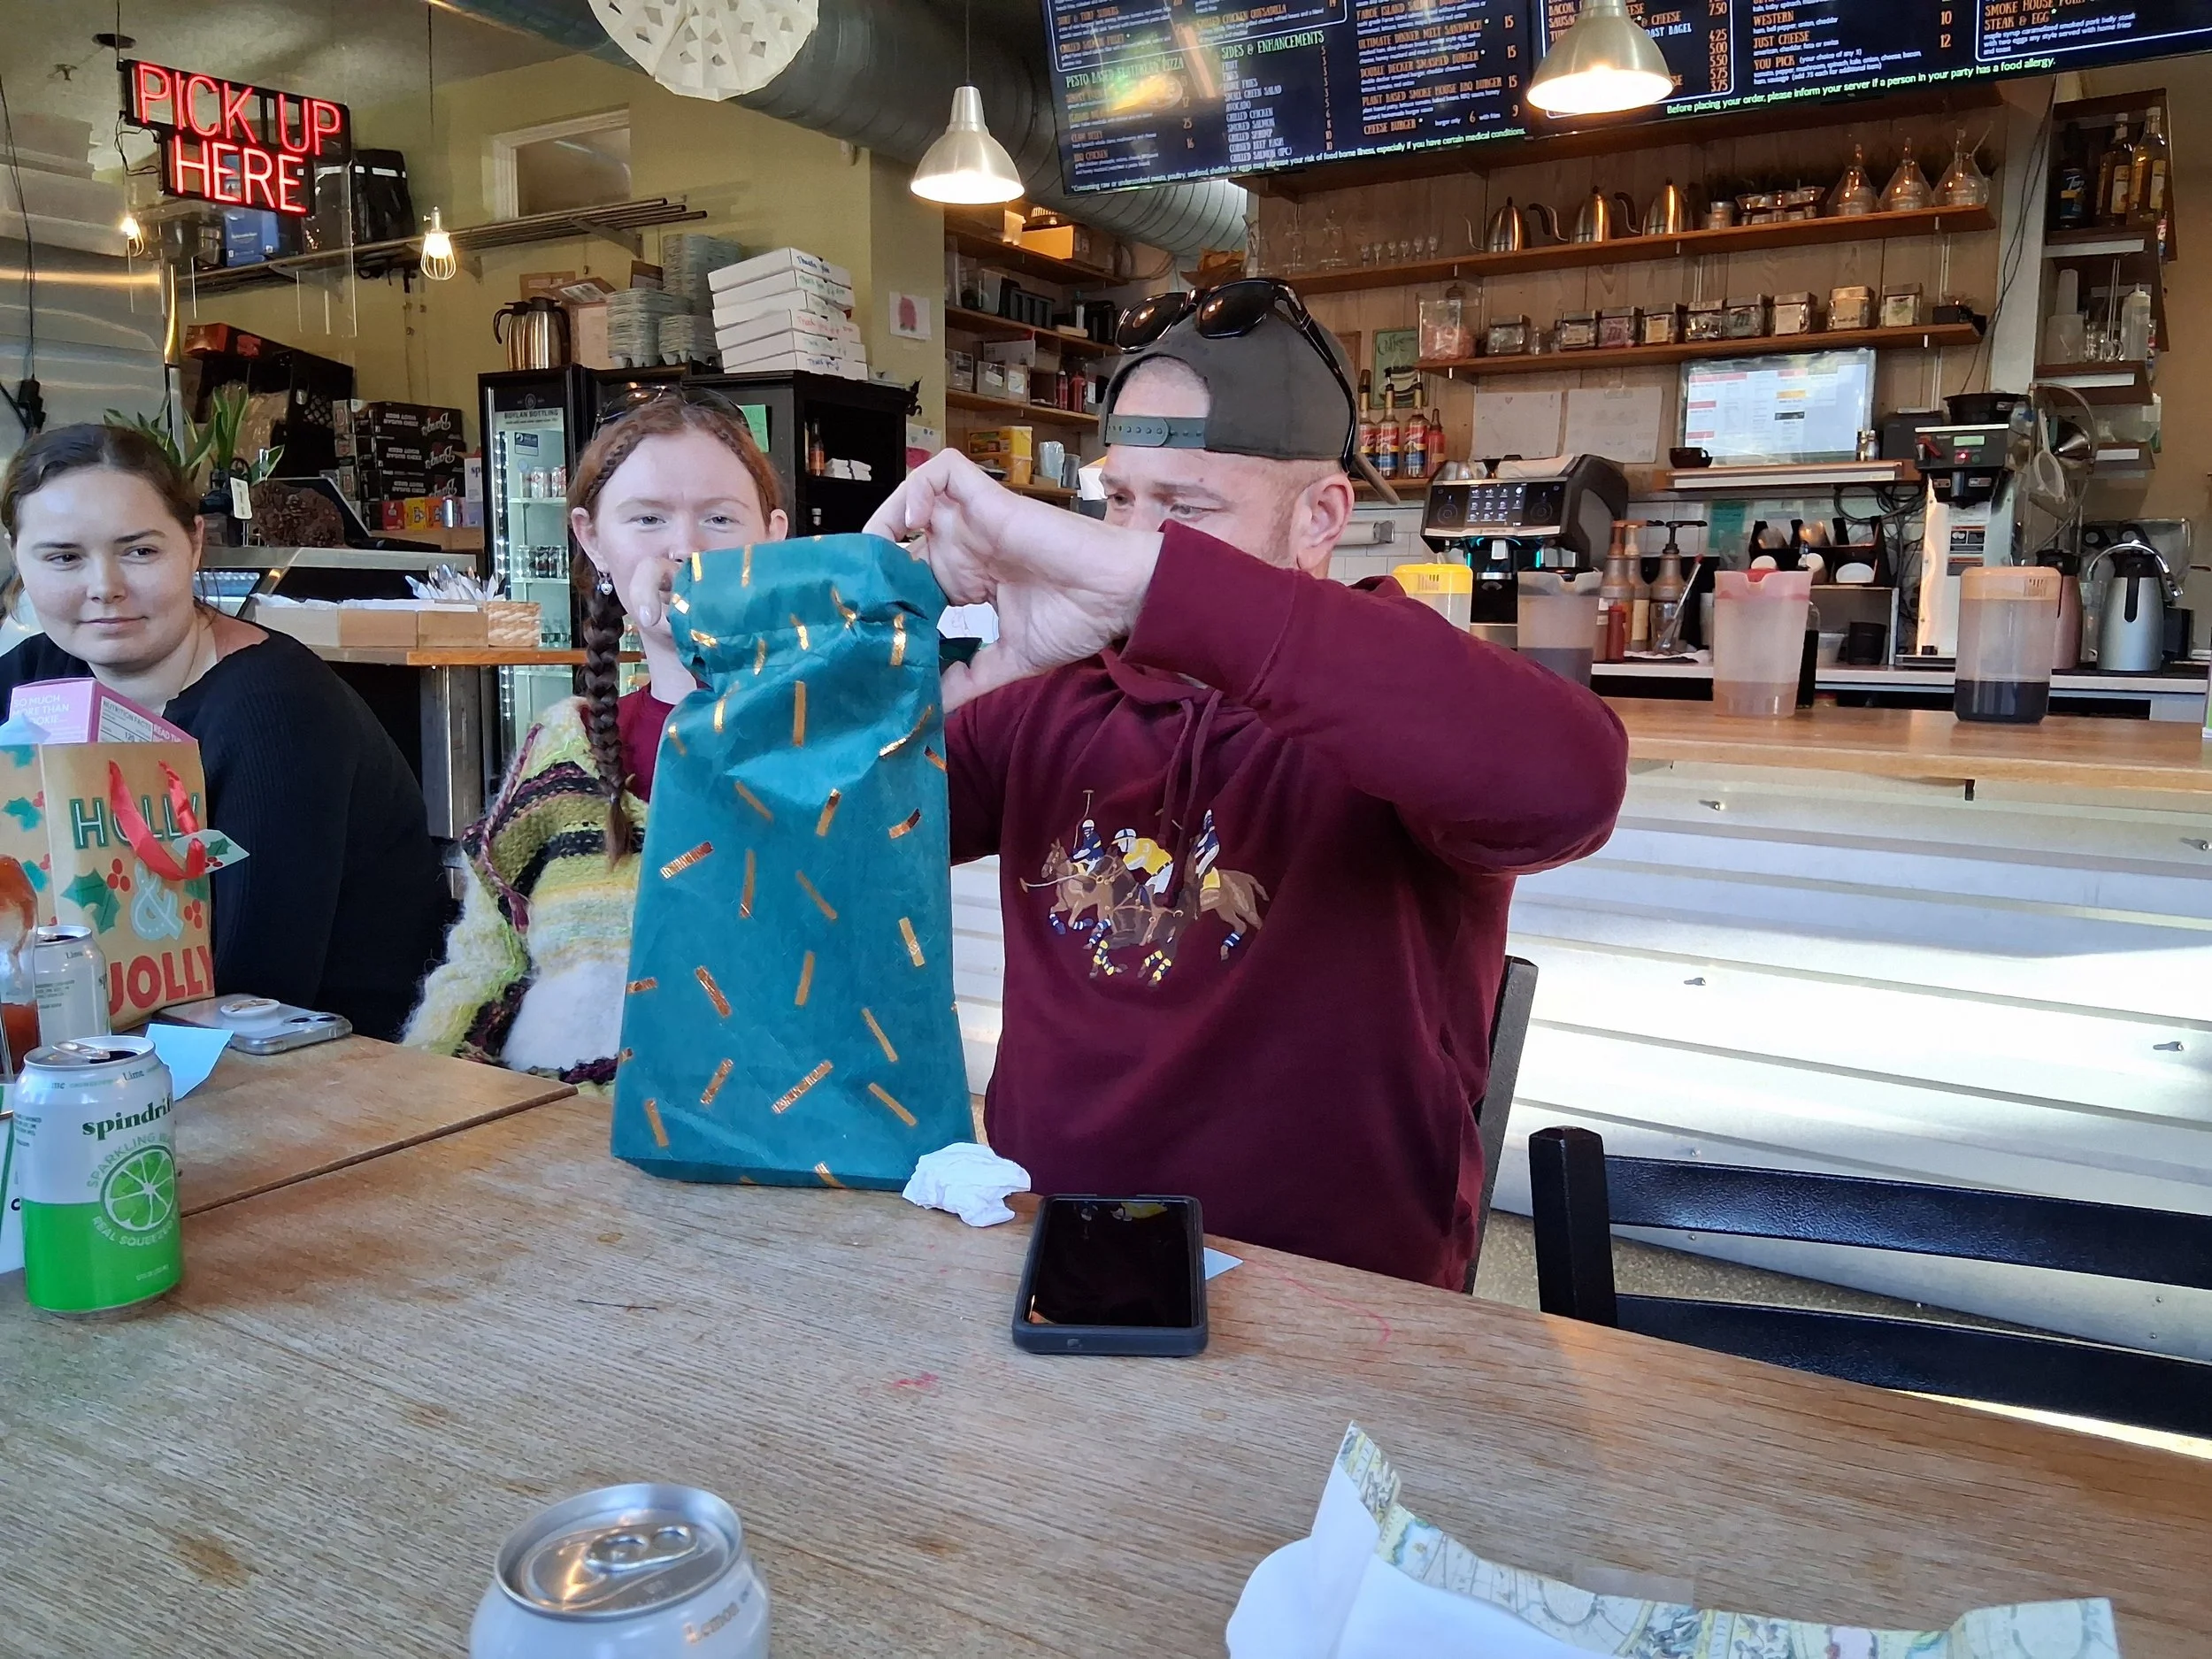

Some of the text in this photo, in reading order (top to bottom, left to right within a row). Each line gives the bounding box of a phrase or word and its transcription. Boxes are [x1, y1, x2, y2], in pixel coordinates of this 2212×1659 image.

[1985, 0, 2054, 17] SMOKE HOUSE
[1504, 15, 1514, 28] 15
[1753, 11, 1953, 27] WESTERN 10
[1985, 18, 2016, 31] STEAK
[2032, 12, 2050, 25] EGG
[1221, 44, 1245, 60] SIDES
[1257, 29, 1325, 54] ENHANCEMENTS
[1753, 30, 1952, 50] JUST CHEESE 12
[1507, 45, 1517, 59] 15
[1753, 58, 1772, 71] YOU
[1775, 55, 1795, 68] PICK
[1064, 73, 1090, 88] PESTO
[1509, 75, 1518, 88] 15
[1667, 104, 1693, 115] Before
[1694, 100, 1721, 112] placing
[1722, 98, 1742, 109] your
[1742, 93, 1767, 104] order,
[1767, 89, 1793, 103] please
[1793, 87, 1821, 98] inform
[1823, 85, 1841, 96] your
[1843, 81, 1870, 92] server
[1887, 75, 1916, 88] person
[1918, 72, 1926, 81] in
[1928, 71, 1948, 83] your
[1951, 67, 1974, 81] party
[1976, 65, 1991, 75] has
[2001, 60, 2023, 72] food
[2024, 58, 2056, 70] allergy.
[137, 61, 342, 157] PICK UP
[1469, 110, 1476, 123] 6
[1511, 104, 1519, 118] 9
[1324, 149, 1339, 160] food
[1411, 140, 1426, 151] you
[1425, 136, 1443, 148] have
[1464, 130, 1491, 142] medical
[173, 134, 309, 214] HERE
[504, 409, 559, 419] BOYLAN BOTTLING
[13, 693, 60, 708] SO MUCH
[42, 703, 70, 713] THAN
[103, 699, 134, 722] NUTRITION
[153, 724, 172, 740] READ
[108, 944, 214, 1017] JOLLY
[122, 1070, 145, 1081] Lime
[82, 1093, 173, 1141] spindrif
[86, 1133, 157, 1188] SPARKLING
[93, 1216, 117, 1241] REAL
[682, 1601, 741, 1644] Lemon
